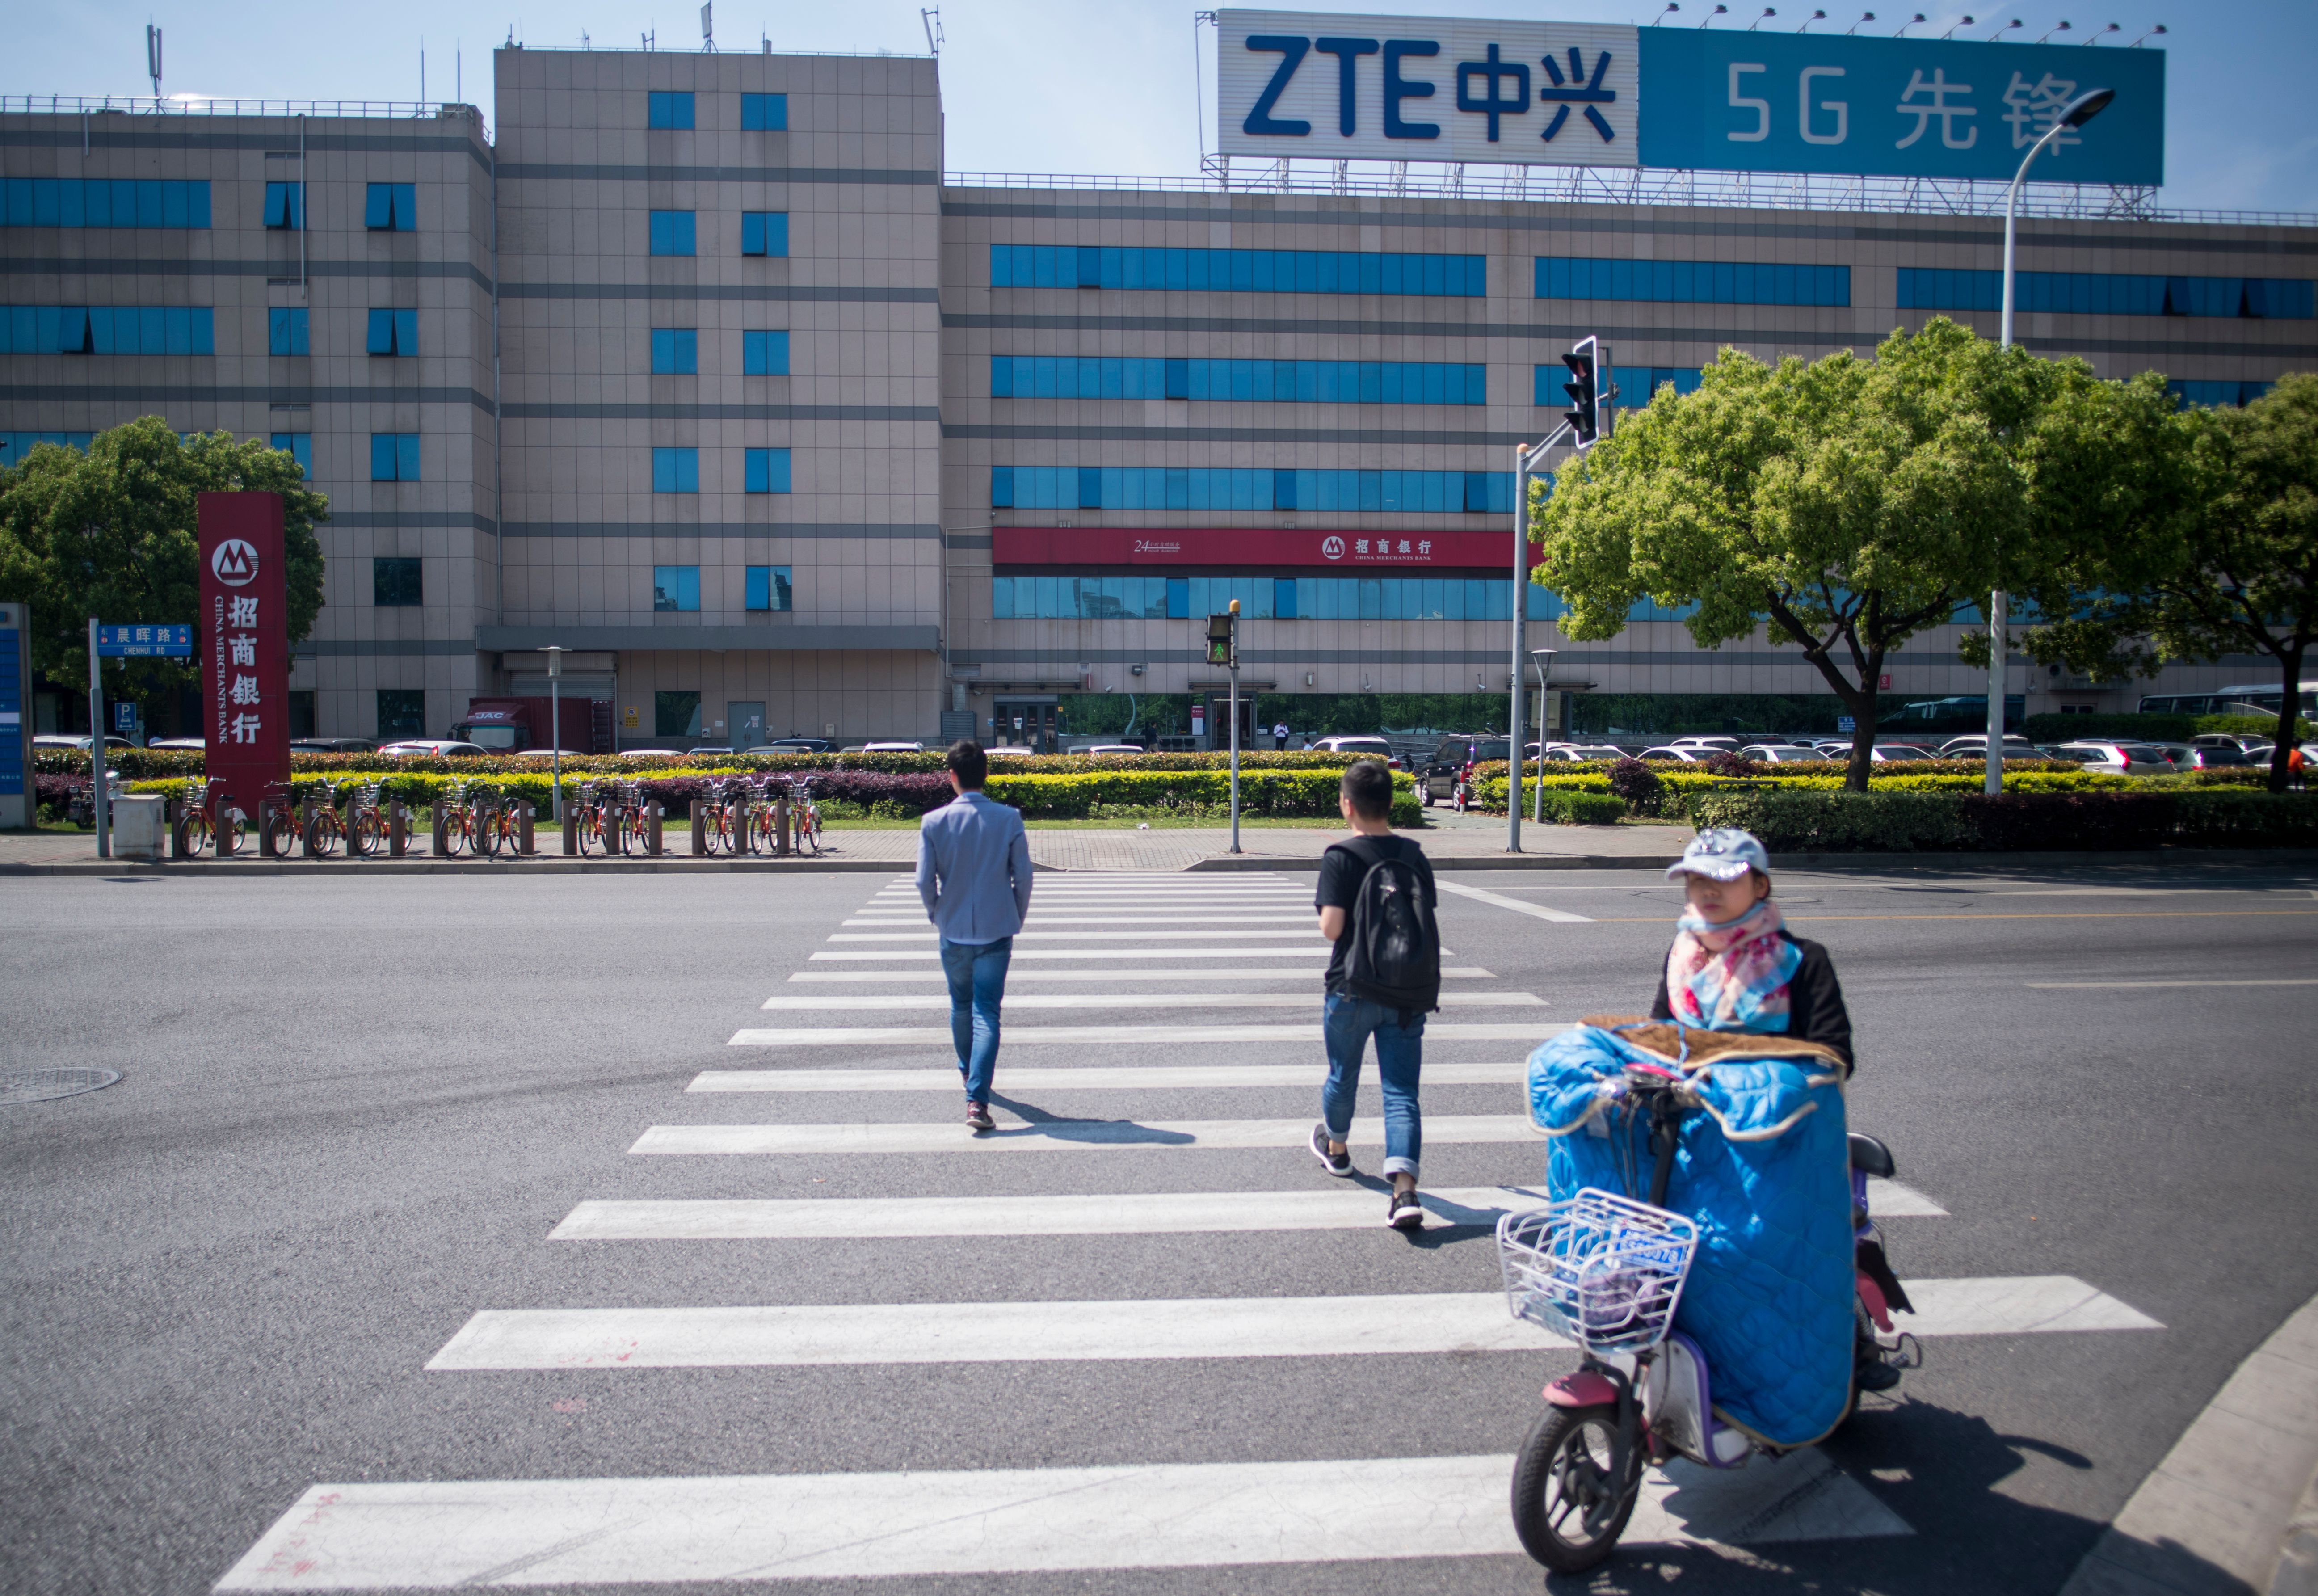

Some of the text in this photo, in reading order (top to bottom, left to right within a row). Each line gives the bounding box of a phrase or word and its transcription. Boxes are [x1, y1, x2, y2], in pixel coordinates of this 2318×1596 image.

[1243, 35, 1616, 143] ZTE 中兴
[1727, 63, 2082, 156] 5G 先锋
[1134, 539, 1150, 552] 24
[117, 628, 171, 643] 晨晖路
[124, 647, 165, 655] CHENHUI RD
[215, 595, 228, 744] CHINA MERCHANTS BANK
[121, 704, 130, 716] P
